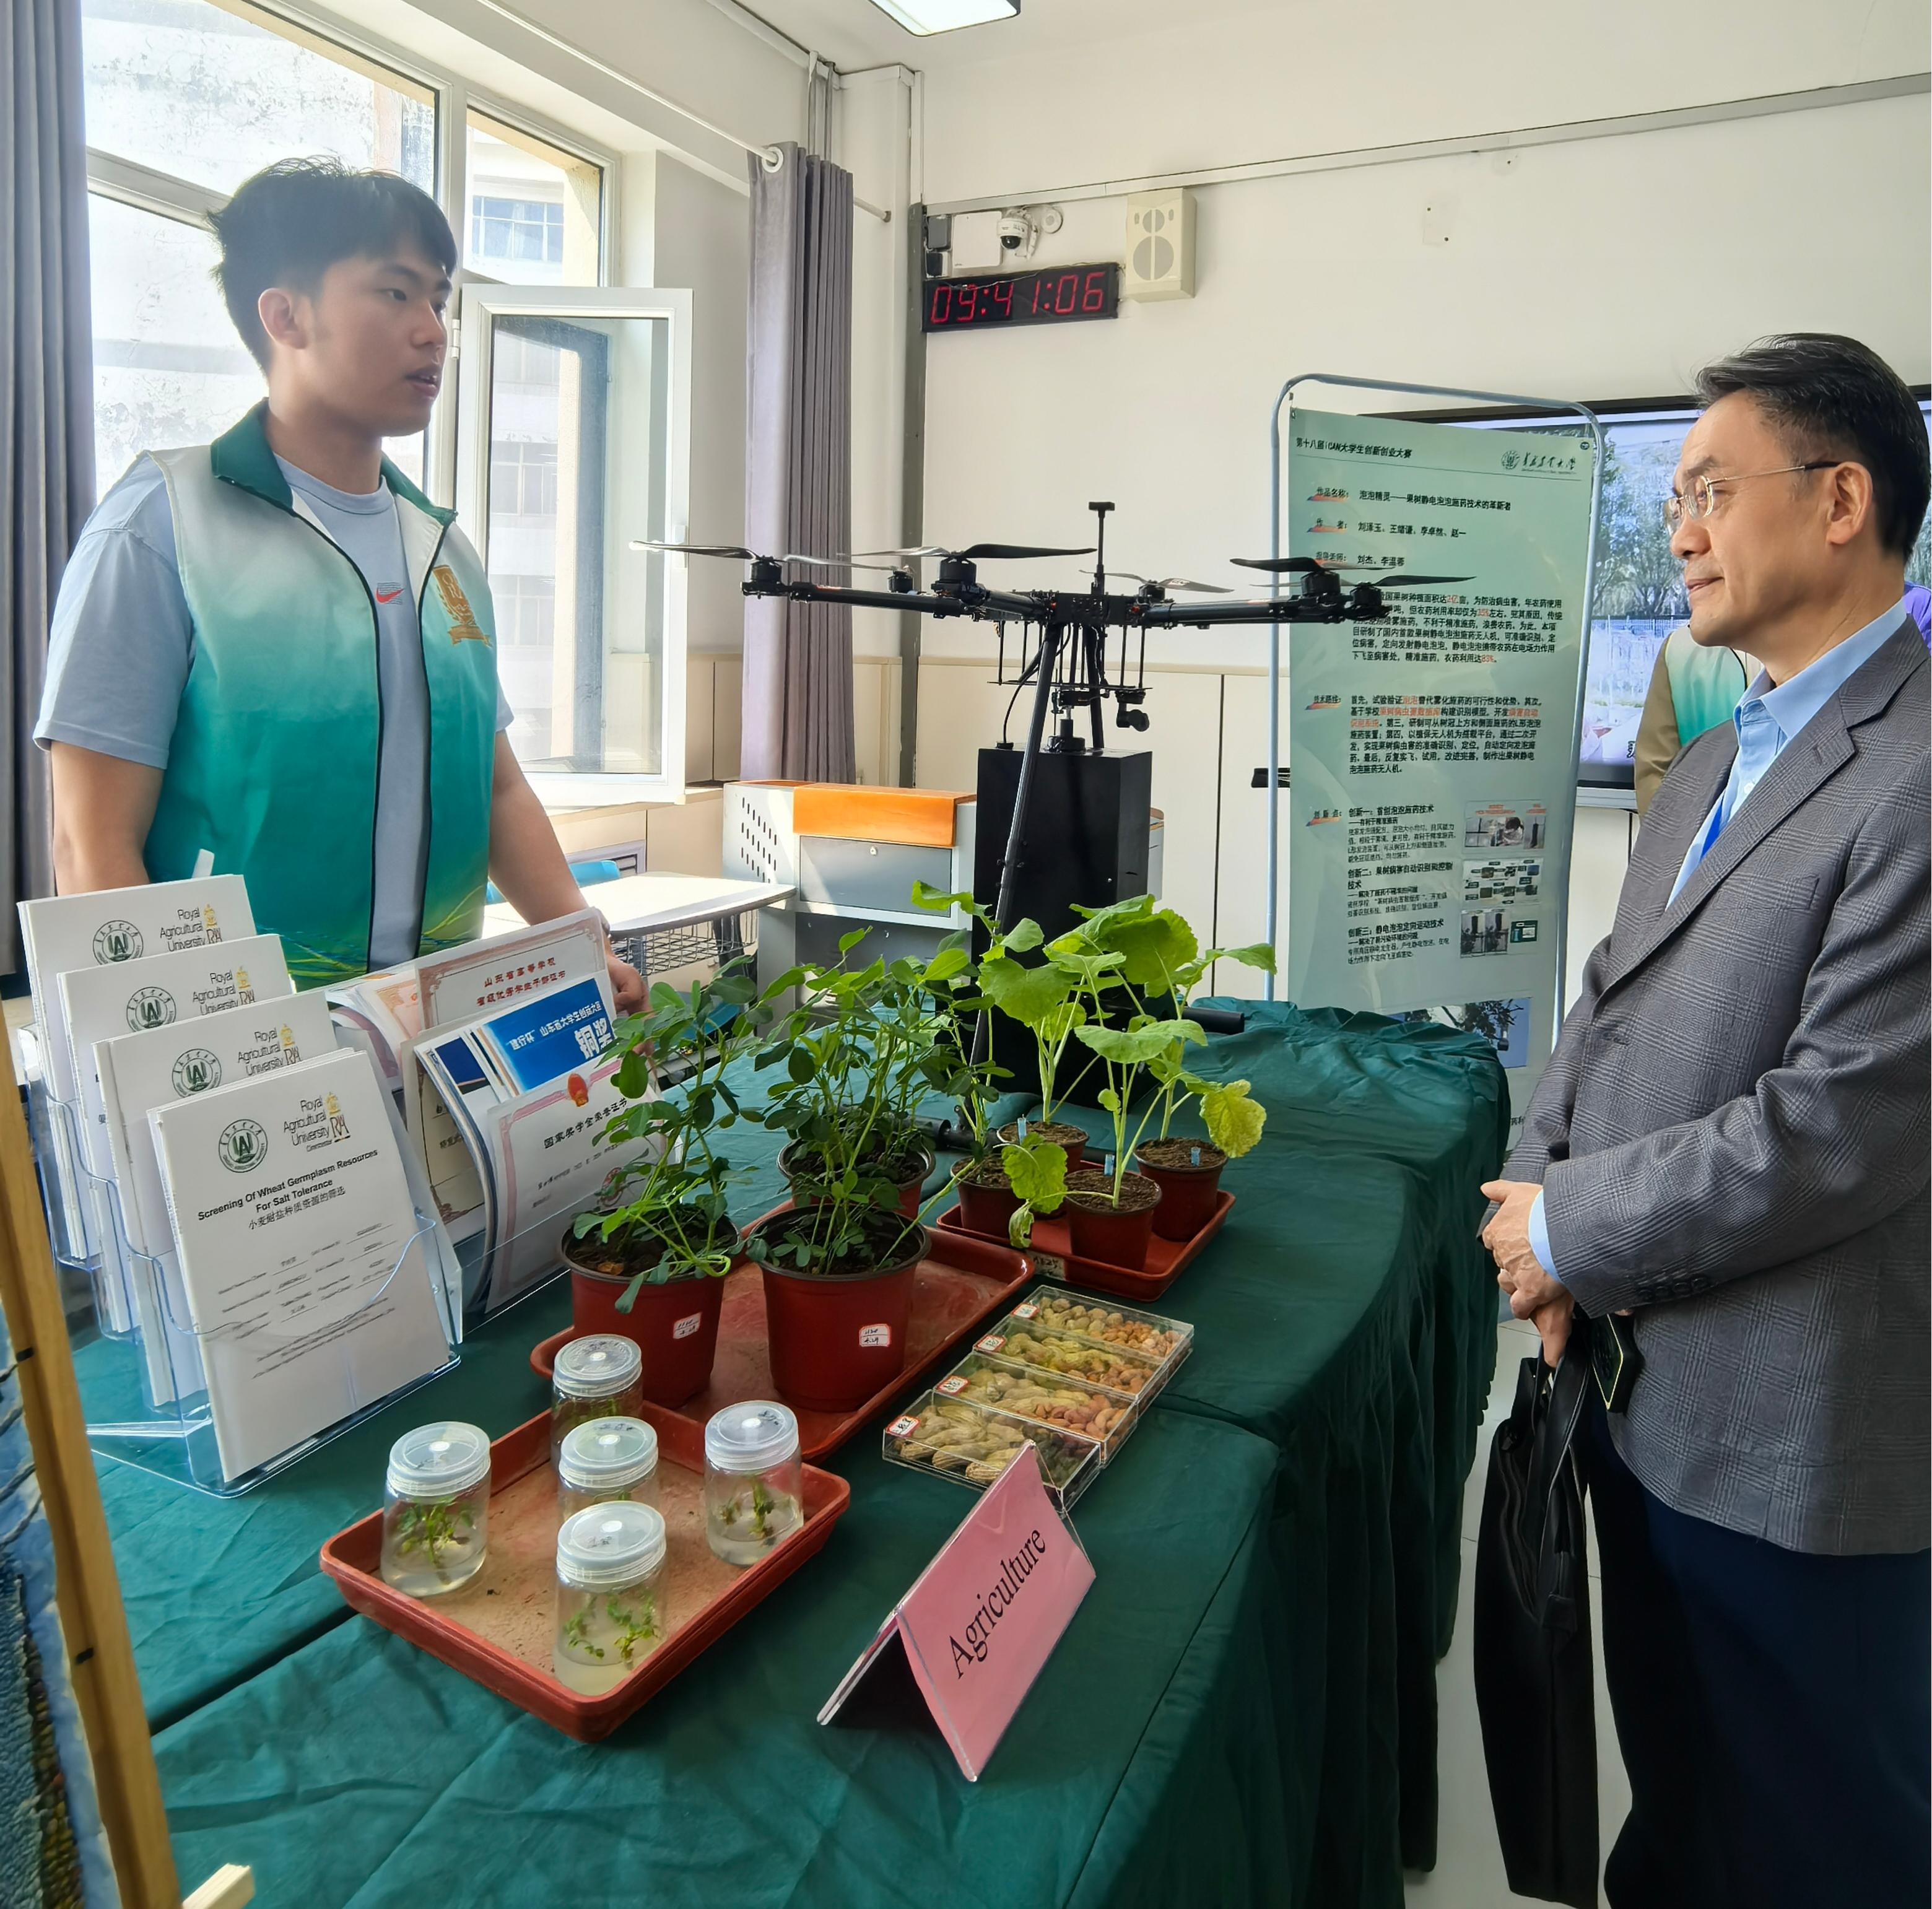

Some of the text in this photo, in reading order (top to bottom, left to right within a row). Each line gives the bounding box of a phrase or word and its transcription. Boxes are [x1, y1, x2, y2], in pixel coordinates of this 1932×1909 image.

[177, 907, 200, 920] Royal
[160, 921, 203, 940] Agricultural
[167, 936, 206, 952] University
[210, 970, 233, 984] Royal
[484, 957, 556, 987] 山东省高等学校
[193, 985, 236, 1004] Agricultural
[200, 999, 238, 1015] University
[255, 1027, 277, 1042] Royal
[238, 1042, 281, 1064] Agricultural
[246, 1057, 284, 1076] University
[300, 1096, 323, 1112] Royal
[284, 1110, 327, 1134] Agricultural
[292, 1126, 330, 1146] University
[198, 1149, 378, 1220] Screening Of Wheat Germplasm Resources
[256, 1179, 333, 1213] For Salt Tolerance
[949, 1529, 1046, 1680] Agriculture
